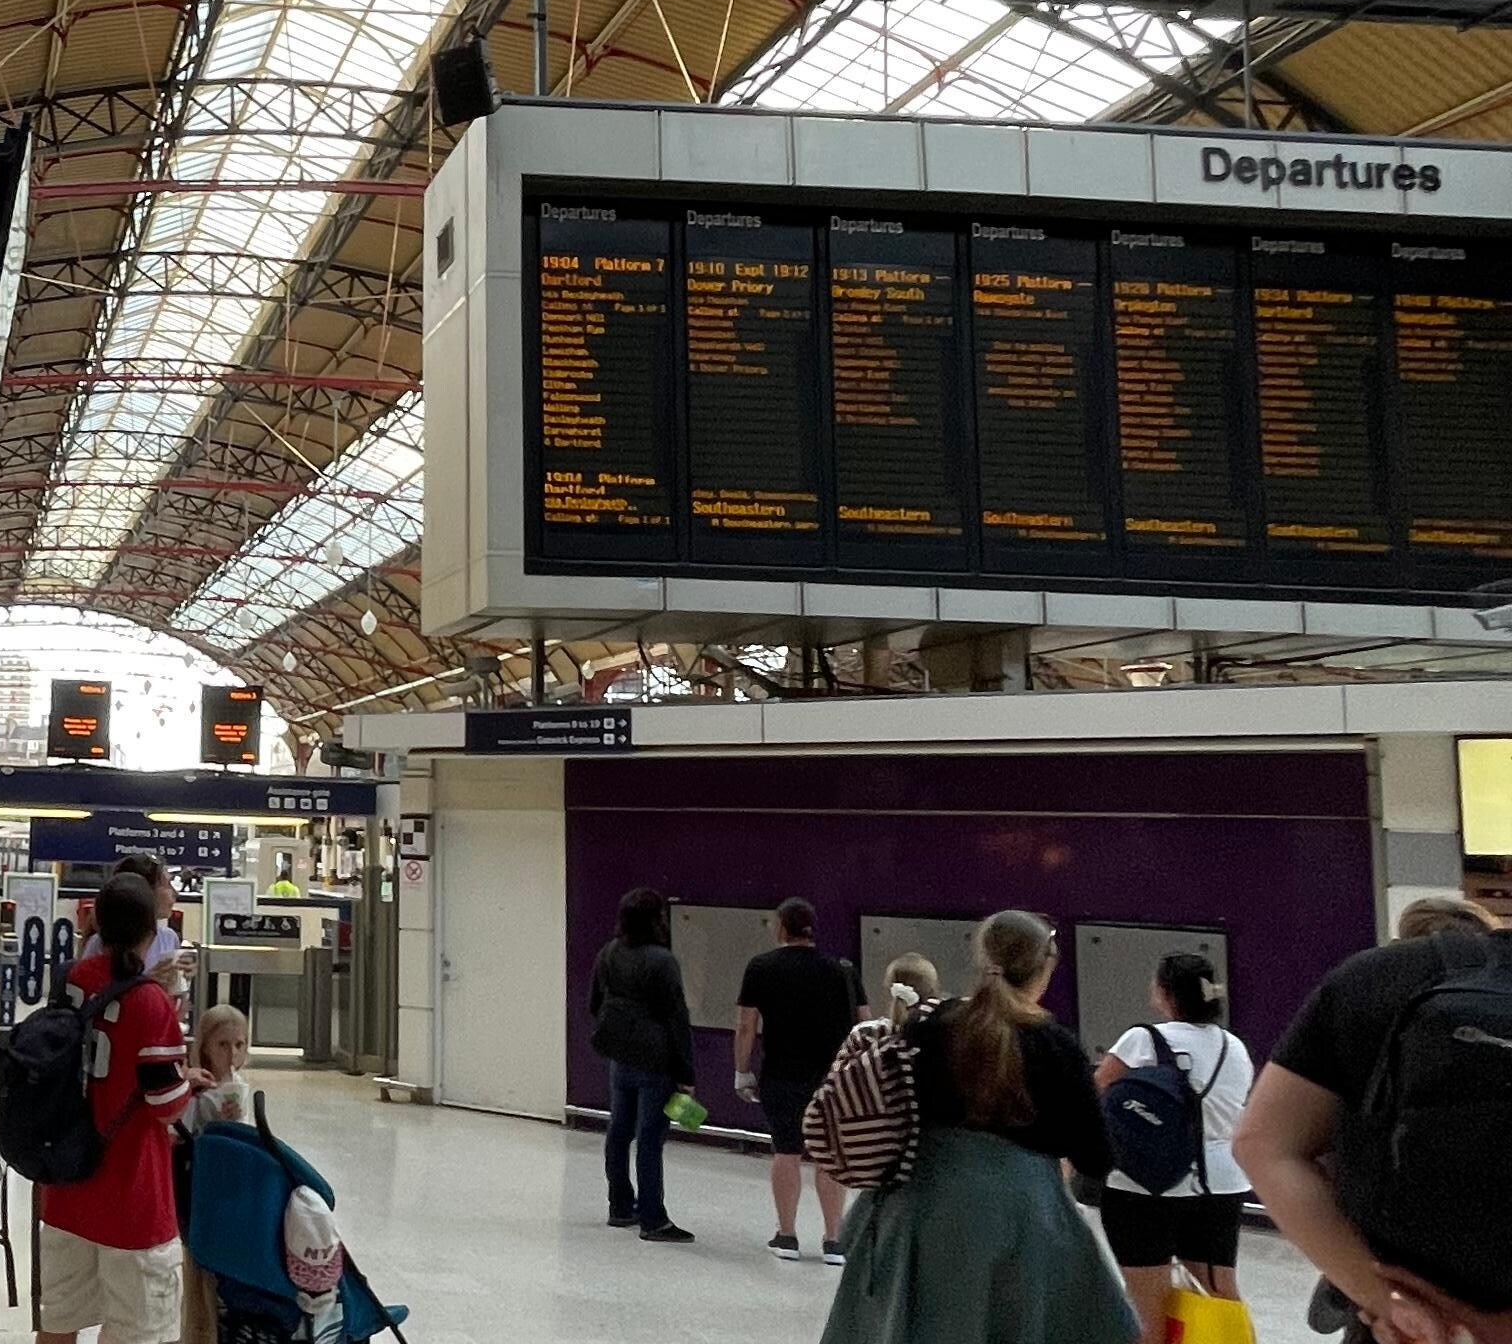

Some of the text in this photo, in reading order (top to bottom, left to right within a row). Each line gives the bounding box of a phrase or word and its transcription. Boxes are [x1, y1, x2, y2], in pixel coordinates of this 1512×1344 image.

[1201, 146, 1442, 193] Departures
[541, 203, 616, 222] Departures
[687, 210, 762, 229] Departures
[831, 215, 904, 235] Departures
[972, 222, 1045, 241] Departures
[542, 256, 665, 272] 19:04 Platform 7
[688, 261, 725, 275] 19:10
[735, 263, 764, 276] Expt
[542, 272, 602, 287] Dartford
[875, 269, 930, 284] Platform
[1017, 275, 1073, 289] Platform
[688, 278, 774, 295] Dover Priory
[886, 287, 925, 301] South
[692, 501, 786, 516] Southeastern
[839, 504, 932, 522] Southeastern
[108, 827, 152, 839] Platforms
[159, 828, 177, 839] and
[115, 844, 158, 855] Platforms
[166, 846, 177, 856] to
[178, 846, 185, 856] 7
[303, 1245, 334, 1260] NY
